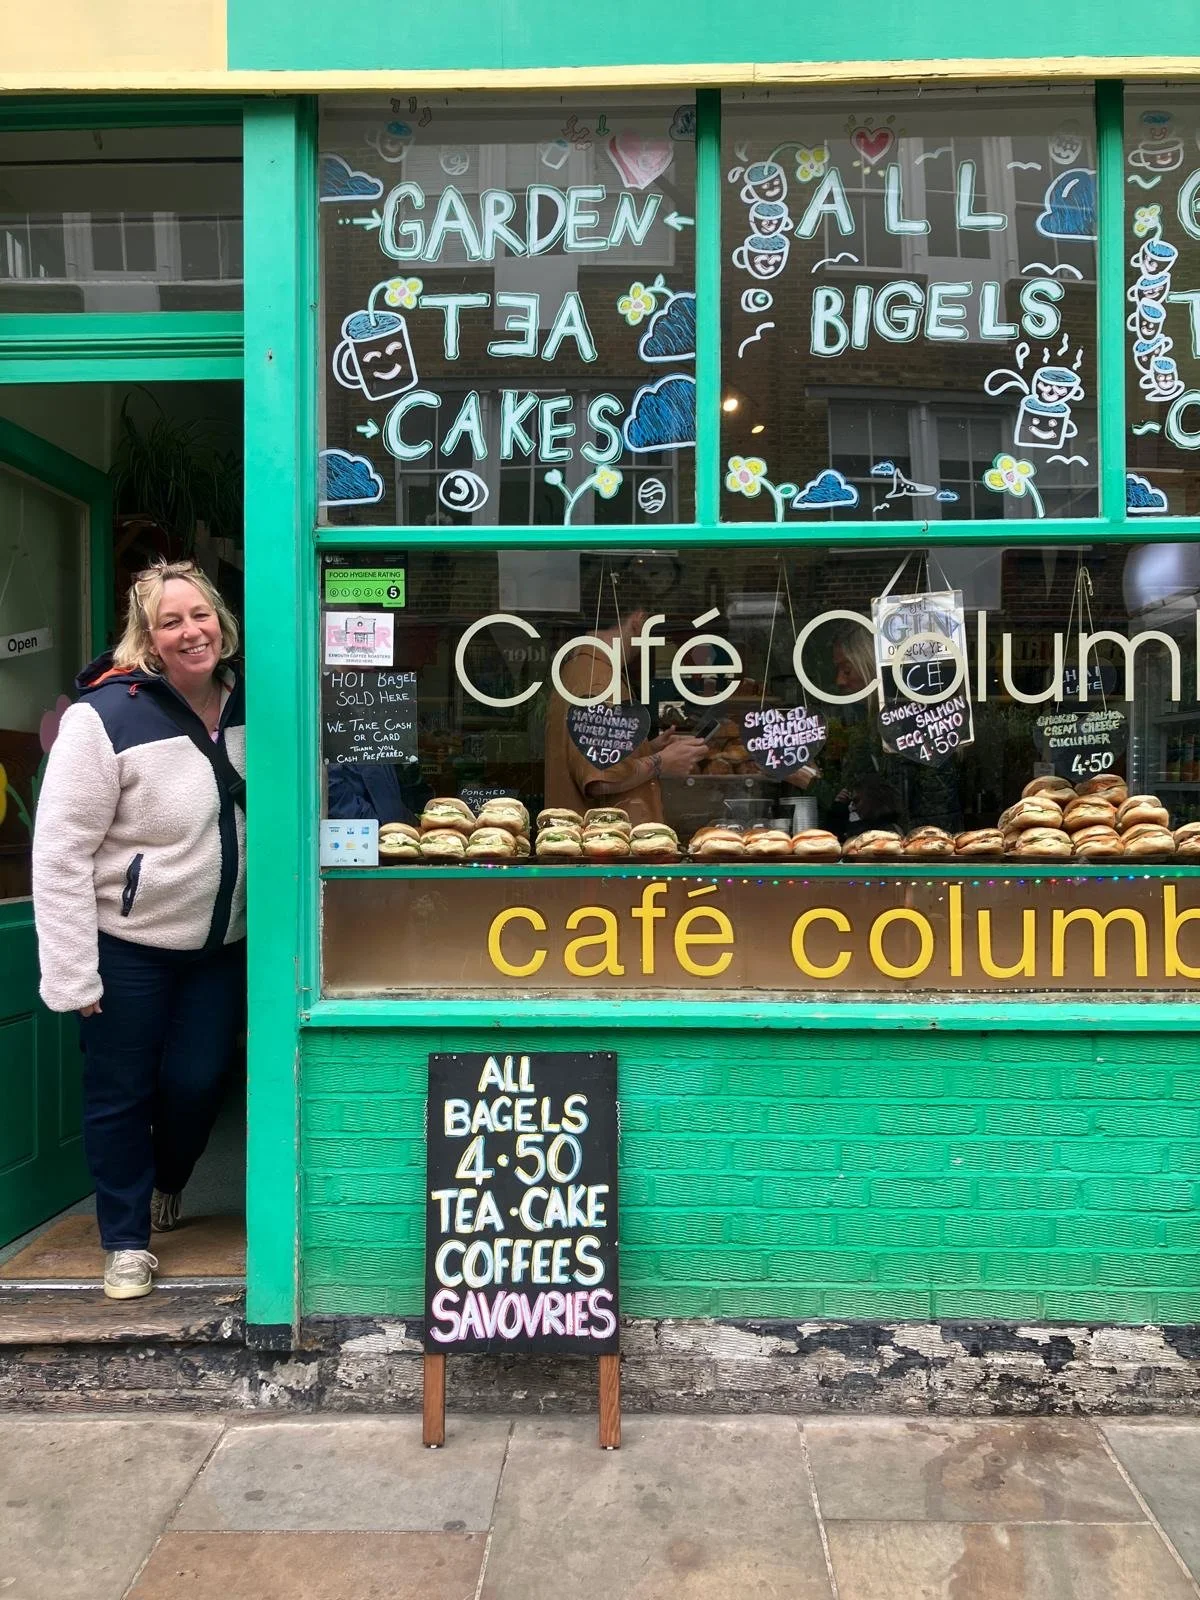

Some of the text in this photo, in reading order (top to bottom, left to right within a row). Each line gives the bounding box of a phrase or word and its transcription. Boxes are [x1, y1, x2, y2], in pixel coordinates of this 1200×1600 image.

[795, 159, 1008, 239] ALL
[380, 182, 663, 261] GARDEN
[810, 278, 1065, 357] BIGELS
[382, 390, 625, 463] CAKES
[882, 609, 955, 644] GIN
[7, 636, 38, 653] Open
[455, 607, 1200, 707] Café Colum
[336, 691, 410, 707] SOLD HERE
[881, 695, 966, 728] SMOKED SALMON
[326, 718, 412, 733] WE TAKE CASH
[353, 731, 400, 742] OR CARD
[573, 722, 636, 740] MIXED LEAF
[579, 734, 634, 751] CUCUMBER
[895, 712, 963, 751] EGG MAYO
[1044, 719, 1120, 737] CREAM CHEESE
[1049, 733, 1111, 748] CUCUMBER
[336, 754, 358, 763] CASH
[377, 745, 395, 753] YOU
[487, 883, 735, 978] café
[478, 1055, 535, 1093] ALL
[444, 1094, 590, 1137] BAGELS
[435, 1235, 605, 1288] COFFEES
